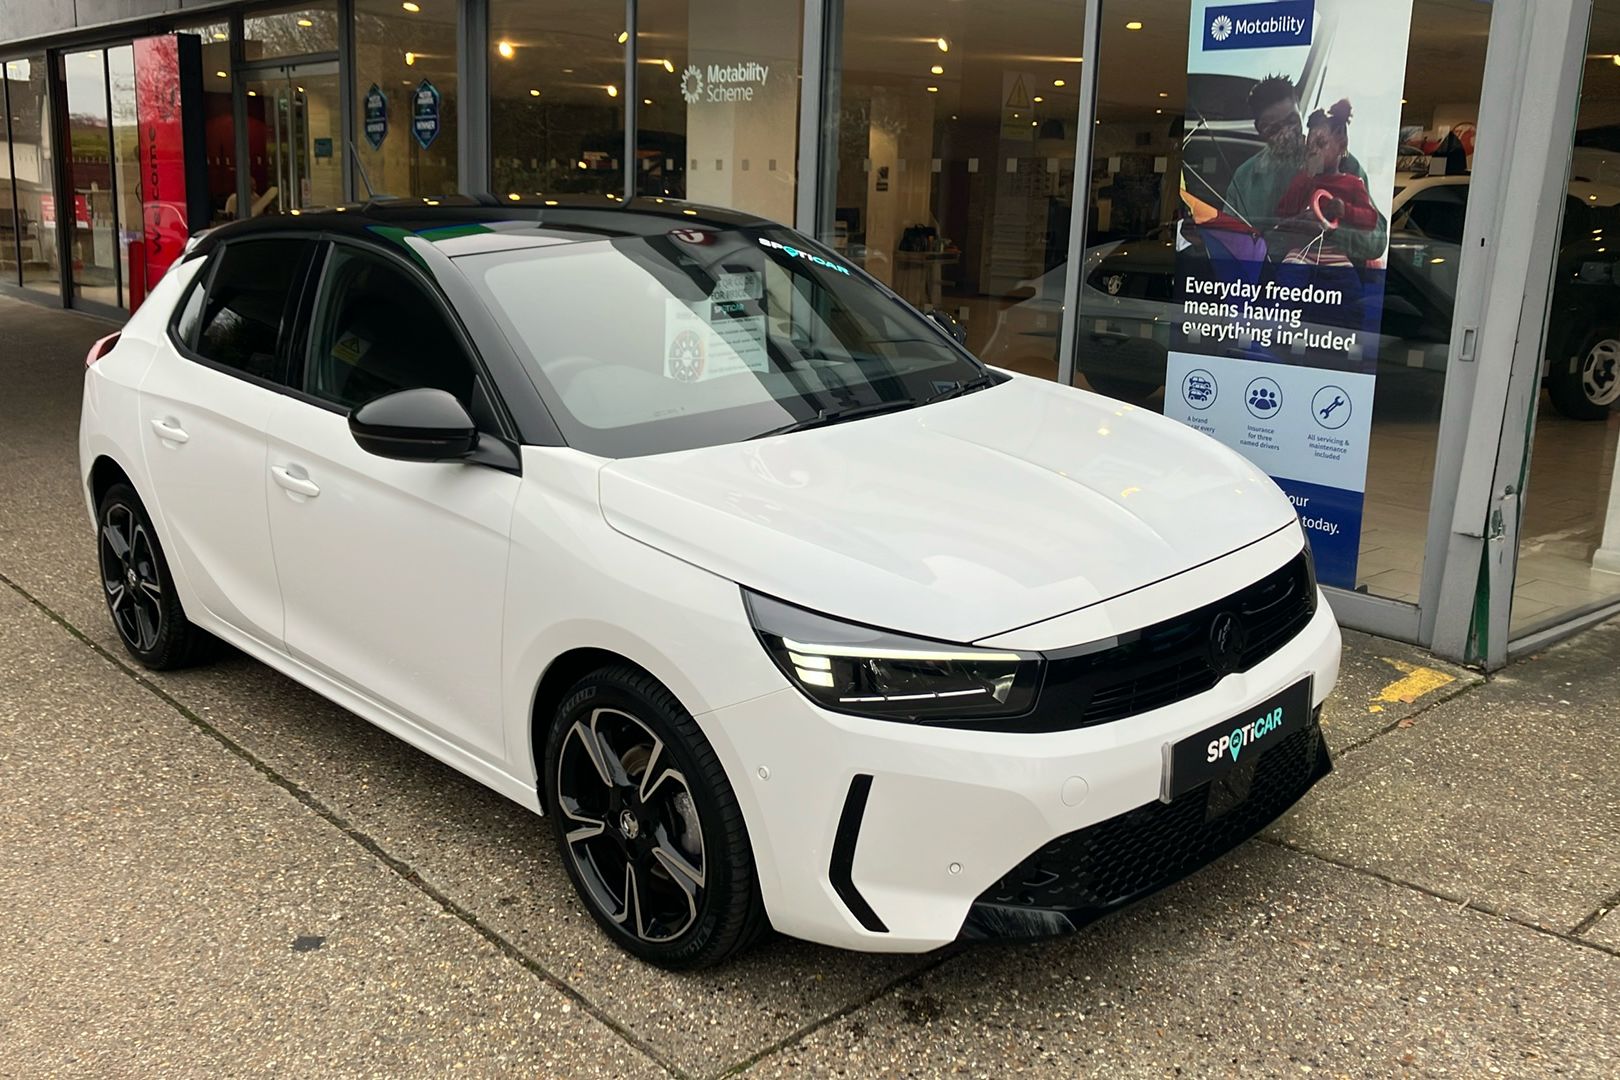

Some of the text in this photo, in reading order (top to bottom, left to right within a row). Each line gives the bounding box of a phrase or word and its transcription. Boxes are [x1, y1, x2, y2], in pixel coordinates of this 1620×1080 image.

[1235, 15, 1305, 36] Motability
[707, 62, 769, 86] Motability
[706, 84, 753, 102] Scheme
[1185, 276, 1343, 305] Everyday freedom
[1184, 300, 1303, 328] means having
[1182, 320, 1273, 347] everything
[1247, 425, 1274, 435] Insurance
[1248, 432, 1273, 442] for three
[1240, 439, 1280, 451] named drivers
[1309, 442, 1347, 454] maintenance
[1317, 435, 1344, 447] servicing
[1314, 450, 1341, 461] included
[1301, 515, 1340, 535] today.
